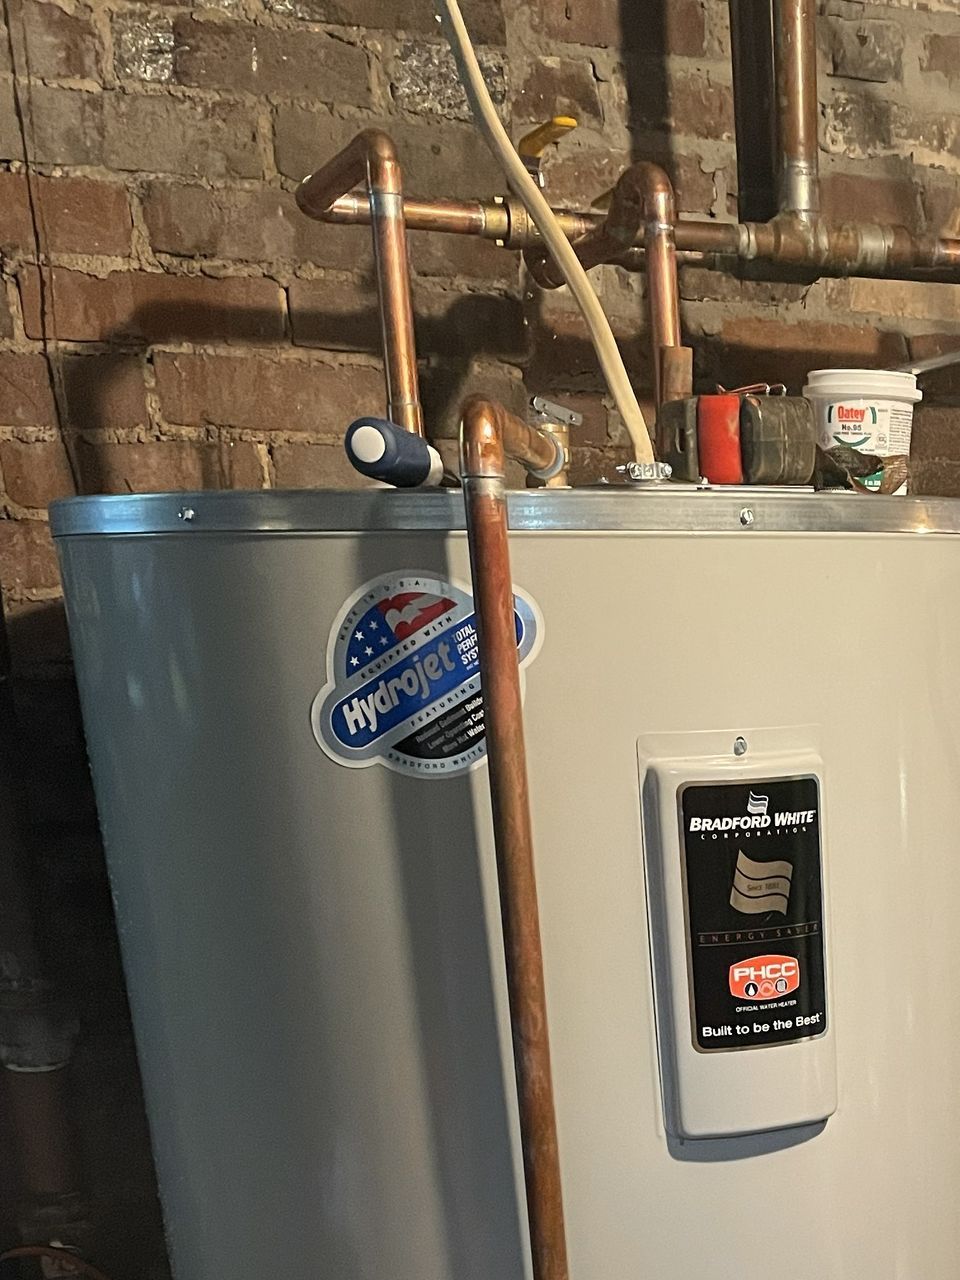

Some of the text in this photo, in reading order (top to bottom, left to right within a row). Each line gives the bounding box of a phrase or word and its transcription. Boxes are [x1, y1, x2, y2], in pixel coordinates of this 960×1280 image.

[838, 406, 865, 420] Oatey
[361, 616, 453, 679] EQUIPPED WITH
[342, 641, 456, 735] Hydrojet
[410, 683, 475, 726] FEATURING
[689, 811, 814, 832] BRADFORD WHITE
[701, 827, 807, 840] CORPORATION
[700, 931, 766, 943] ENERGY
[734, 962, 796, 982] PHCC
[702, 1013, 820, 1037] Built to be the Best
